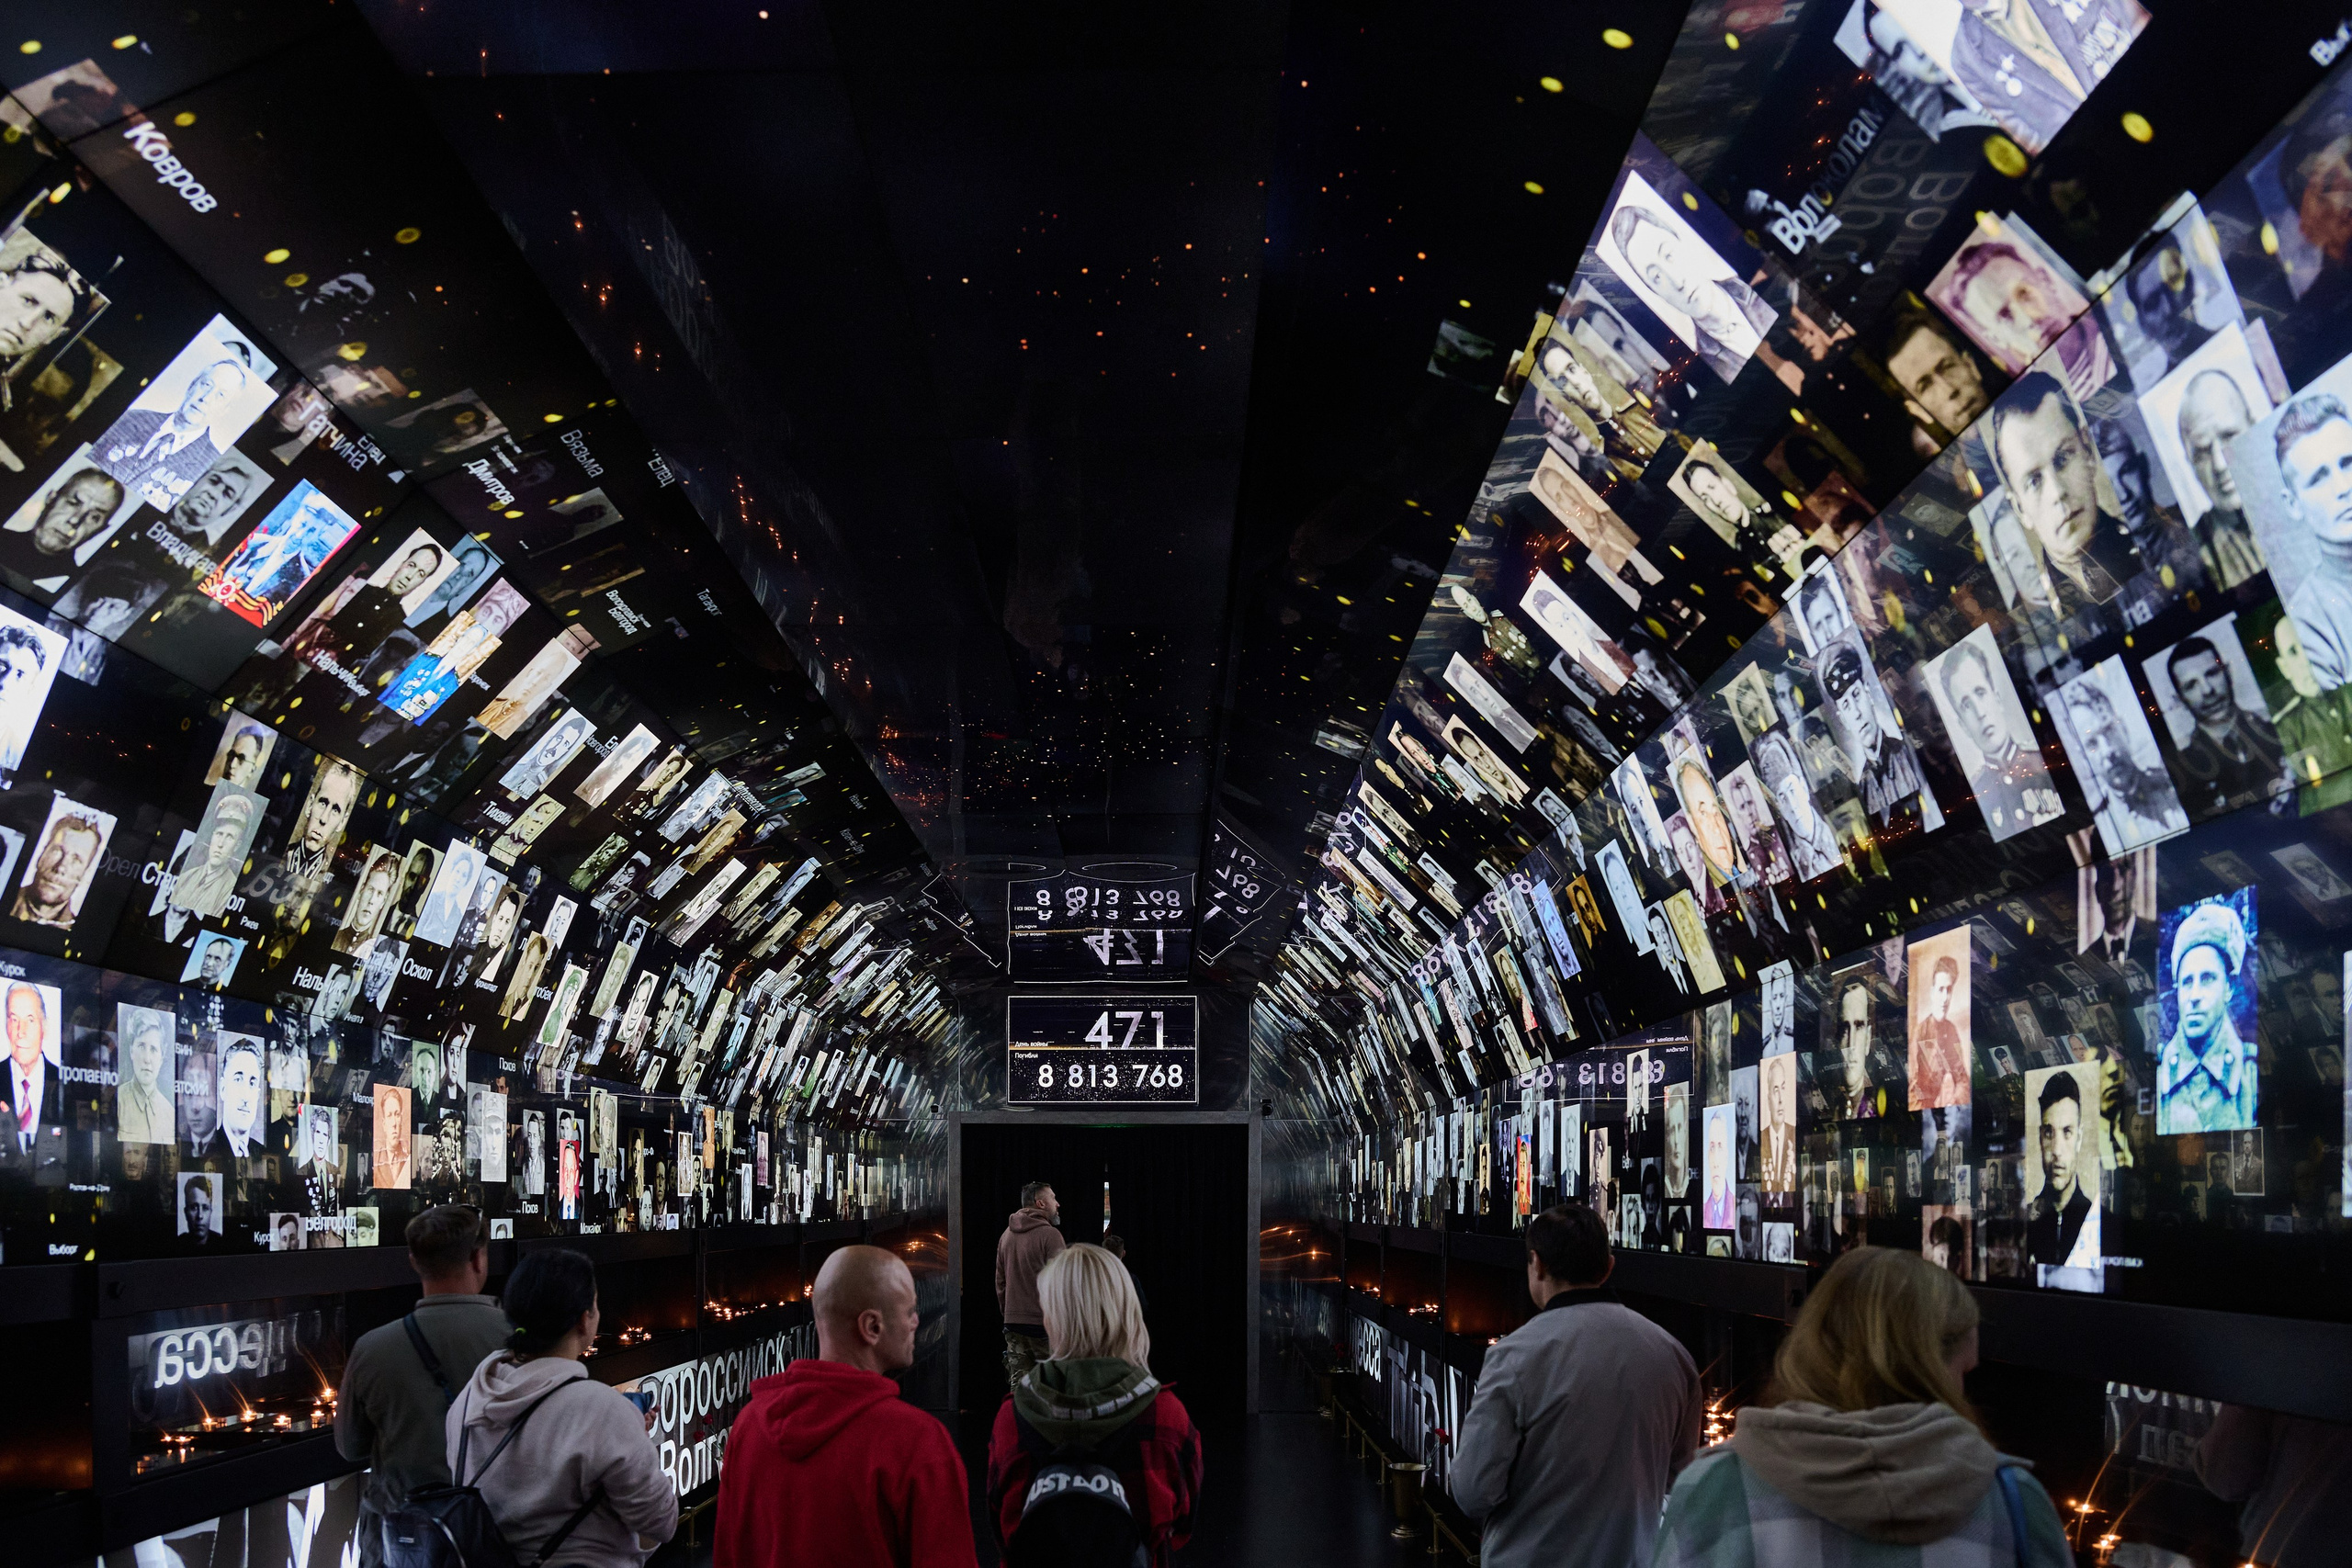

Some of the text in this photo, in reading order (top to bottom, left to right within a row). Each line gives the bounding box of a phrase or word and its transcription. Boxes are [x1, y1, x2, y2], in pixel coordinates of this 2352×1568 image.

[123, 121, 219, 213] Ковров
[298, 400, 369, 472] Гатчина
[560, 429, 604, 479] Вязьма
[462, 458, 515, 506] Дмитров
[146, 521, 219, 576] Владикав
[482, 800, 514, 827] Тихвин
[401, 957, 434, 982] Оскол
[1014, 1040, 1030, 1048] День
[1084, 1010, 1165, 1050] 471
[499, 1056, 516, 1073] Псков
[1014, 1052, 1039, 1060] Погибли
[1038, 1064, 1184, 1088] 8 813 768
[522, 1201, 538, 1214] Псков
[645, 1330, 787, 1447] вороссийск
[660, 1433, 728, 1499] Волг
[1073, 1473, 1110, 1494] DO
